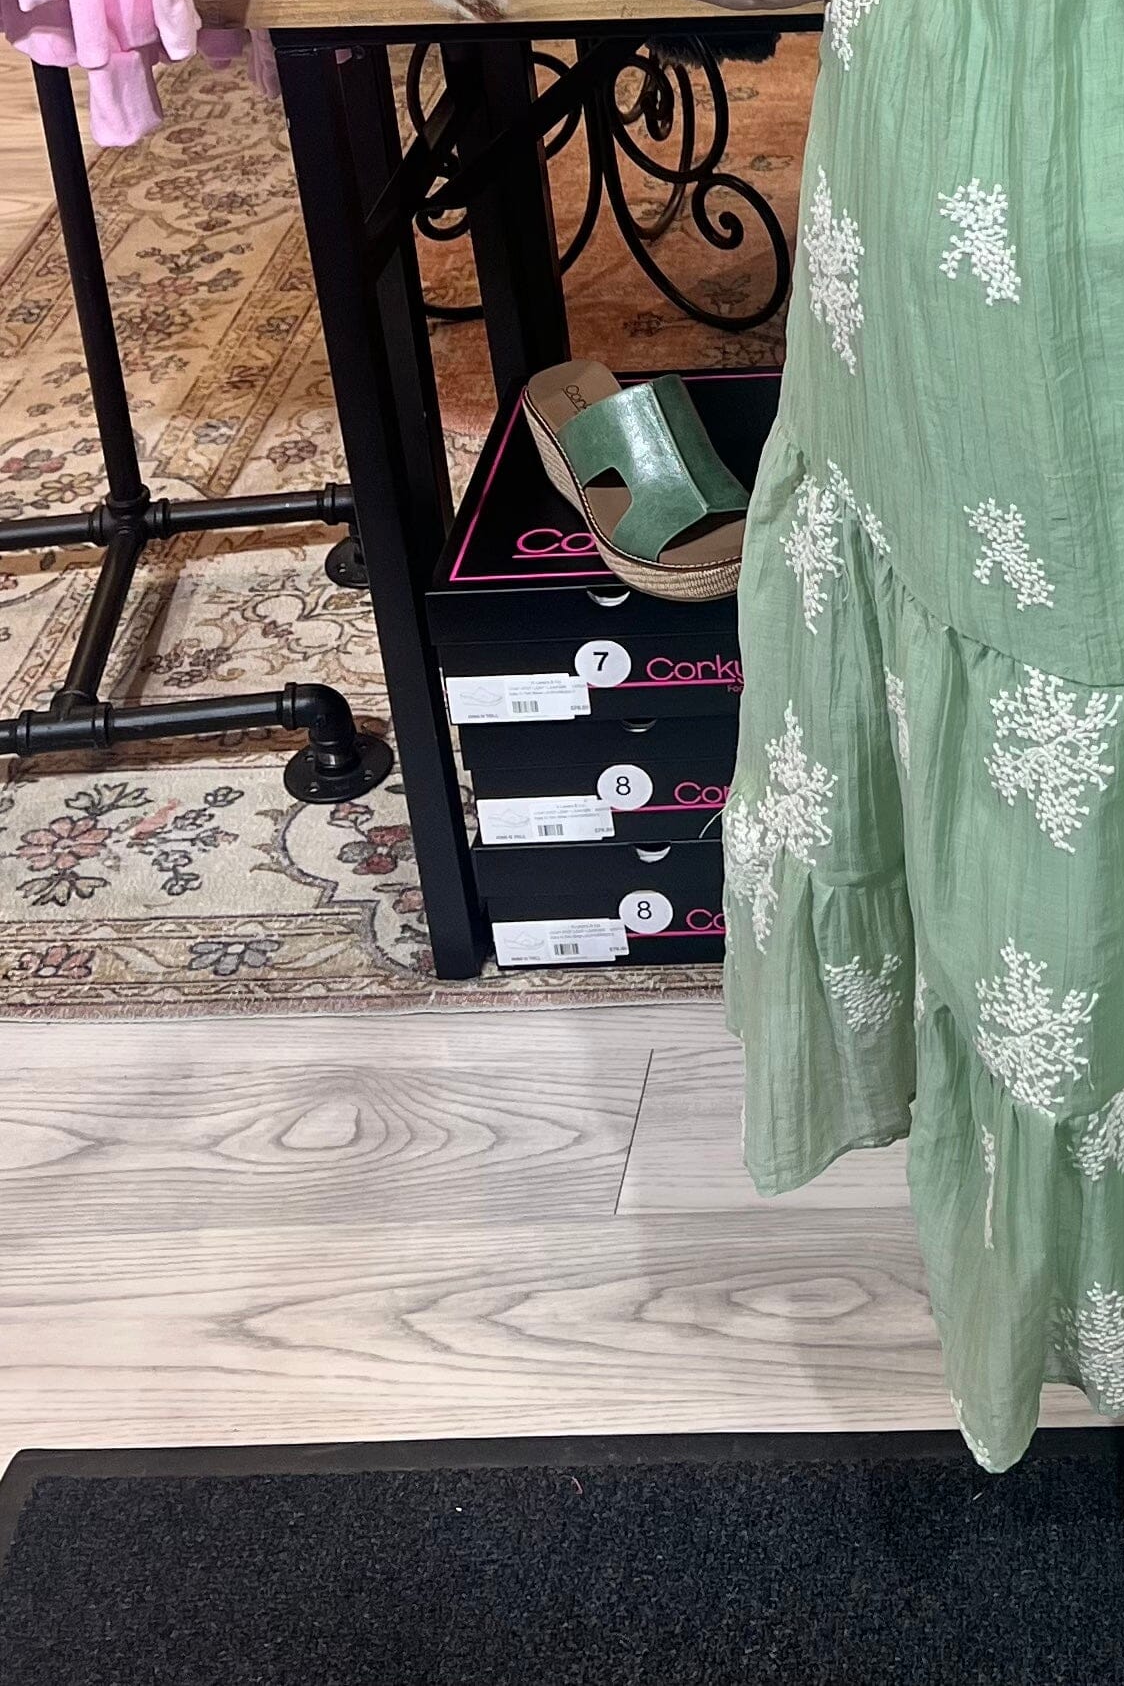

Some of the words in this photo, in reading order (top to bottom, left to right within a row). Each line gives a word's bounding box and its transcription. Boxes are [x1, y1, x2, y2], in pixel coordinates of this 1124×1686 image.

[593, 651, 609, 672] 7
[615, 775, 631, 796] 8
[636, 900, 652, 920] 8
